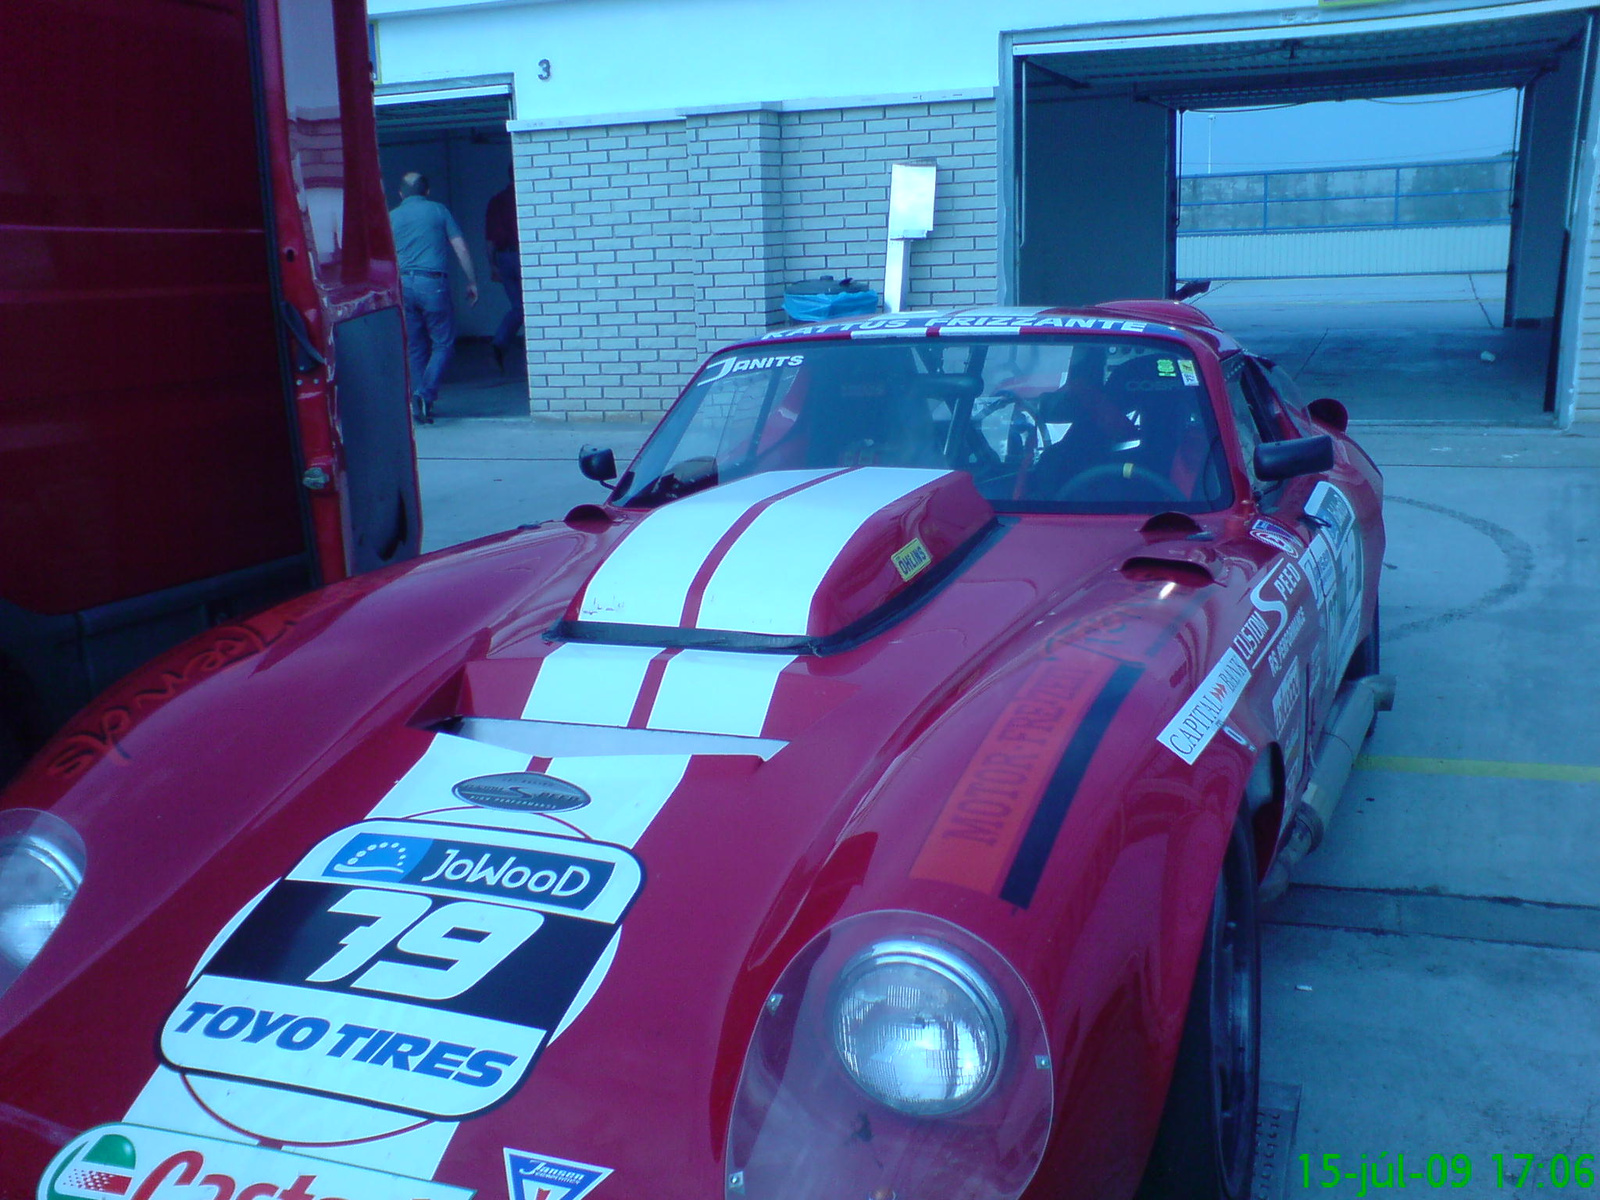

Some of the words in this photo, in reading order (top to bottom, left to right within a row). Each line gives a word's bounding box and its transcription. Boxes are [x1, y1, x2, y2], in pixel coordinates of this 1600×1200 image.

[538, 59, 551, 81] 3
[761, 319, 911, 340] KATTUS
[925, 316, 1147, 333] FRIZZANTE
[1233, 611, 1270, 660] CUSTOM
[1169, 695, 1224, 755] CAPITAL
[1218, 655, 1247, 692] BANK
[942, 750, 1038, 847] MOTOR
[304, 888, 546, 1000] 79
[174, 1001, 331, 1051] TOYO
[325, 1023, 519, 1088] TIRES
